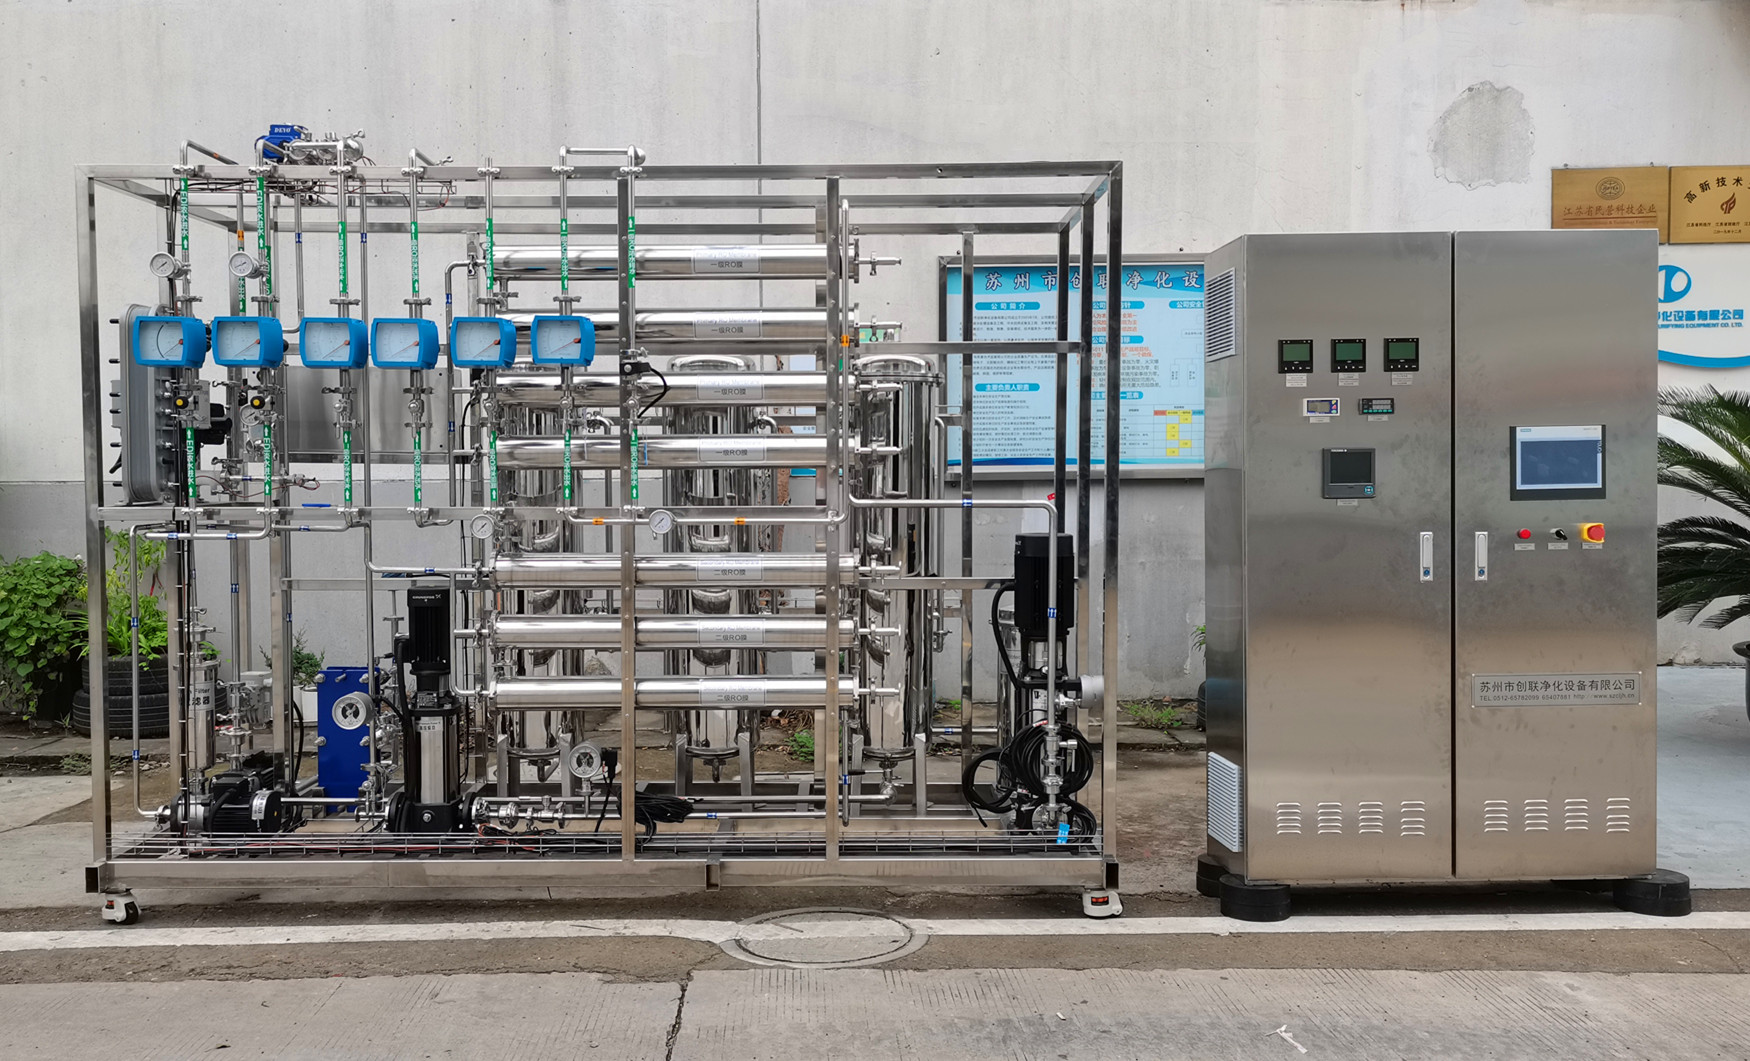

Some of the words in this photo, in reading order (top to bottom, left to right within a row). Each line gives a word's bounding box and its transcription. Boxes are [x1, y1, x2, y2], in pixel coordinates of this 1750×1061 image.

[1684, 176, 1750, 204] 高新技术
[1563, 204, 1656, 217] 江苏省民营科技企业
[1658, 309, 1744, 321] 化设备有限公司
[1479, 679, 1635, 693] 苏州市创联净化设备有限公司
